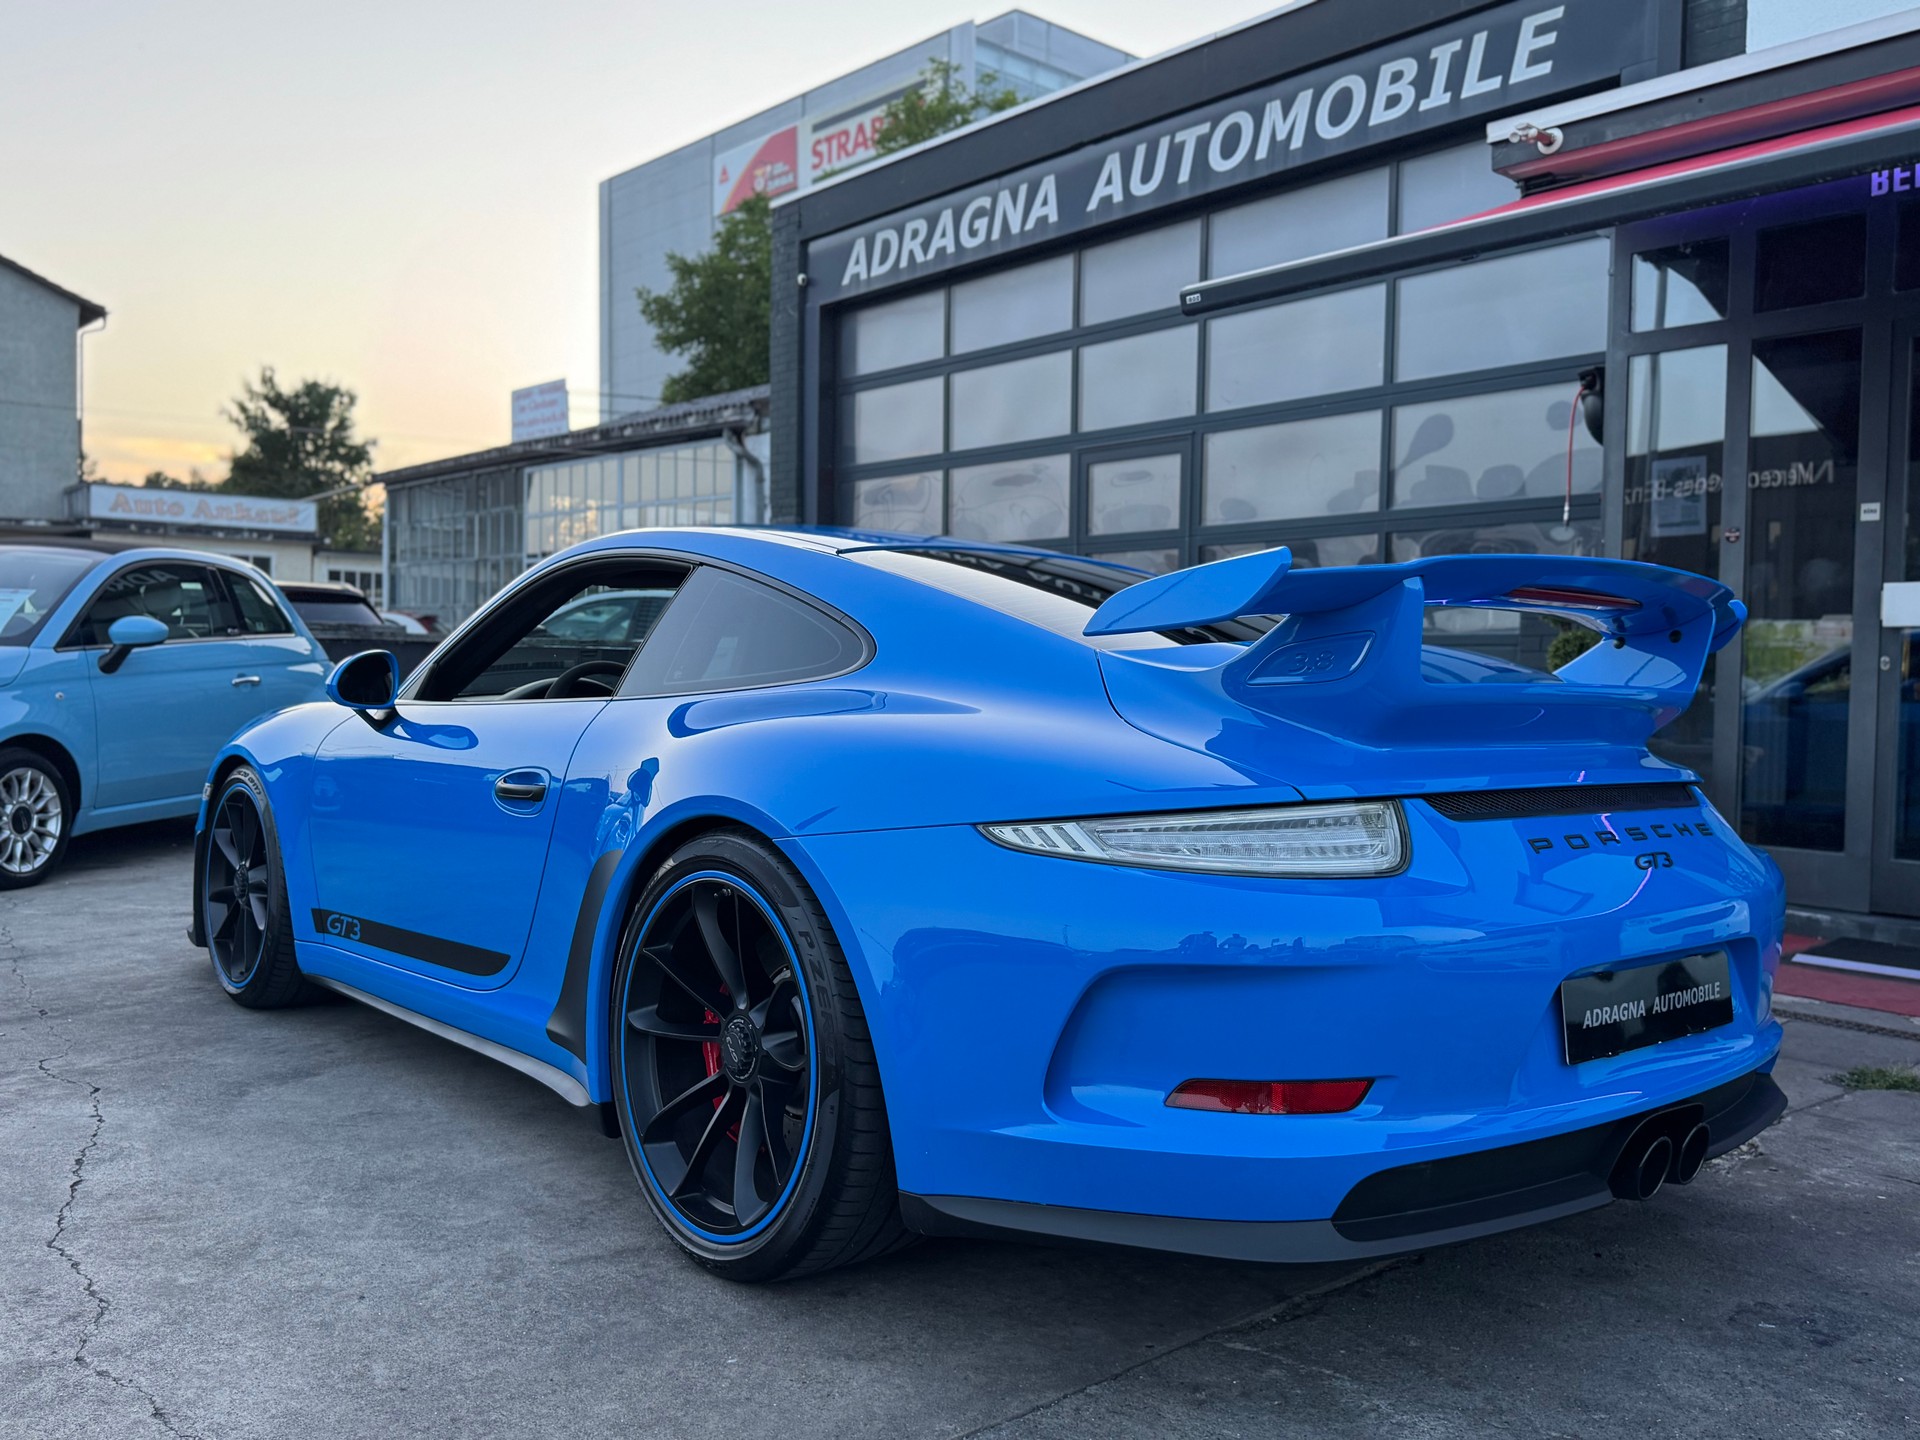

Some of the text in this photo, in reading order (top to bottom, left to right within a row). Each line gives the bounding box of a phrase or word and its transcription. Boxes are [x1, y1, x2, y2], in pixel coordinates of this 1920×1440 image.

[811, 115, 890, 170] STRAB
[840, 5, 1566, 287] ADRAGNA AUTOMOBILE
[109, 492, 184, 516] Auto
[1527, 822, 1714, 854] PORSCHE
[1634, 851, 1674, 871] GT3
[326, 913, 361, 940] GT3
[1582, 981, 1721, 1030] ADRAGNA AUTOMOBILE
